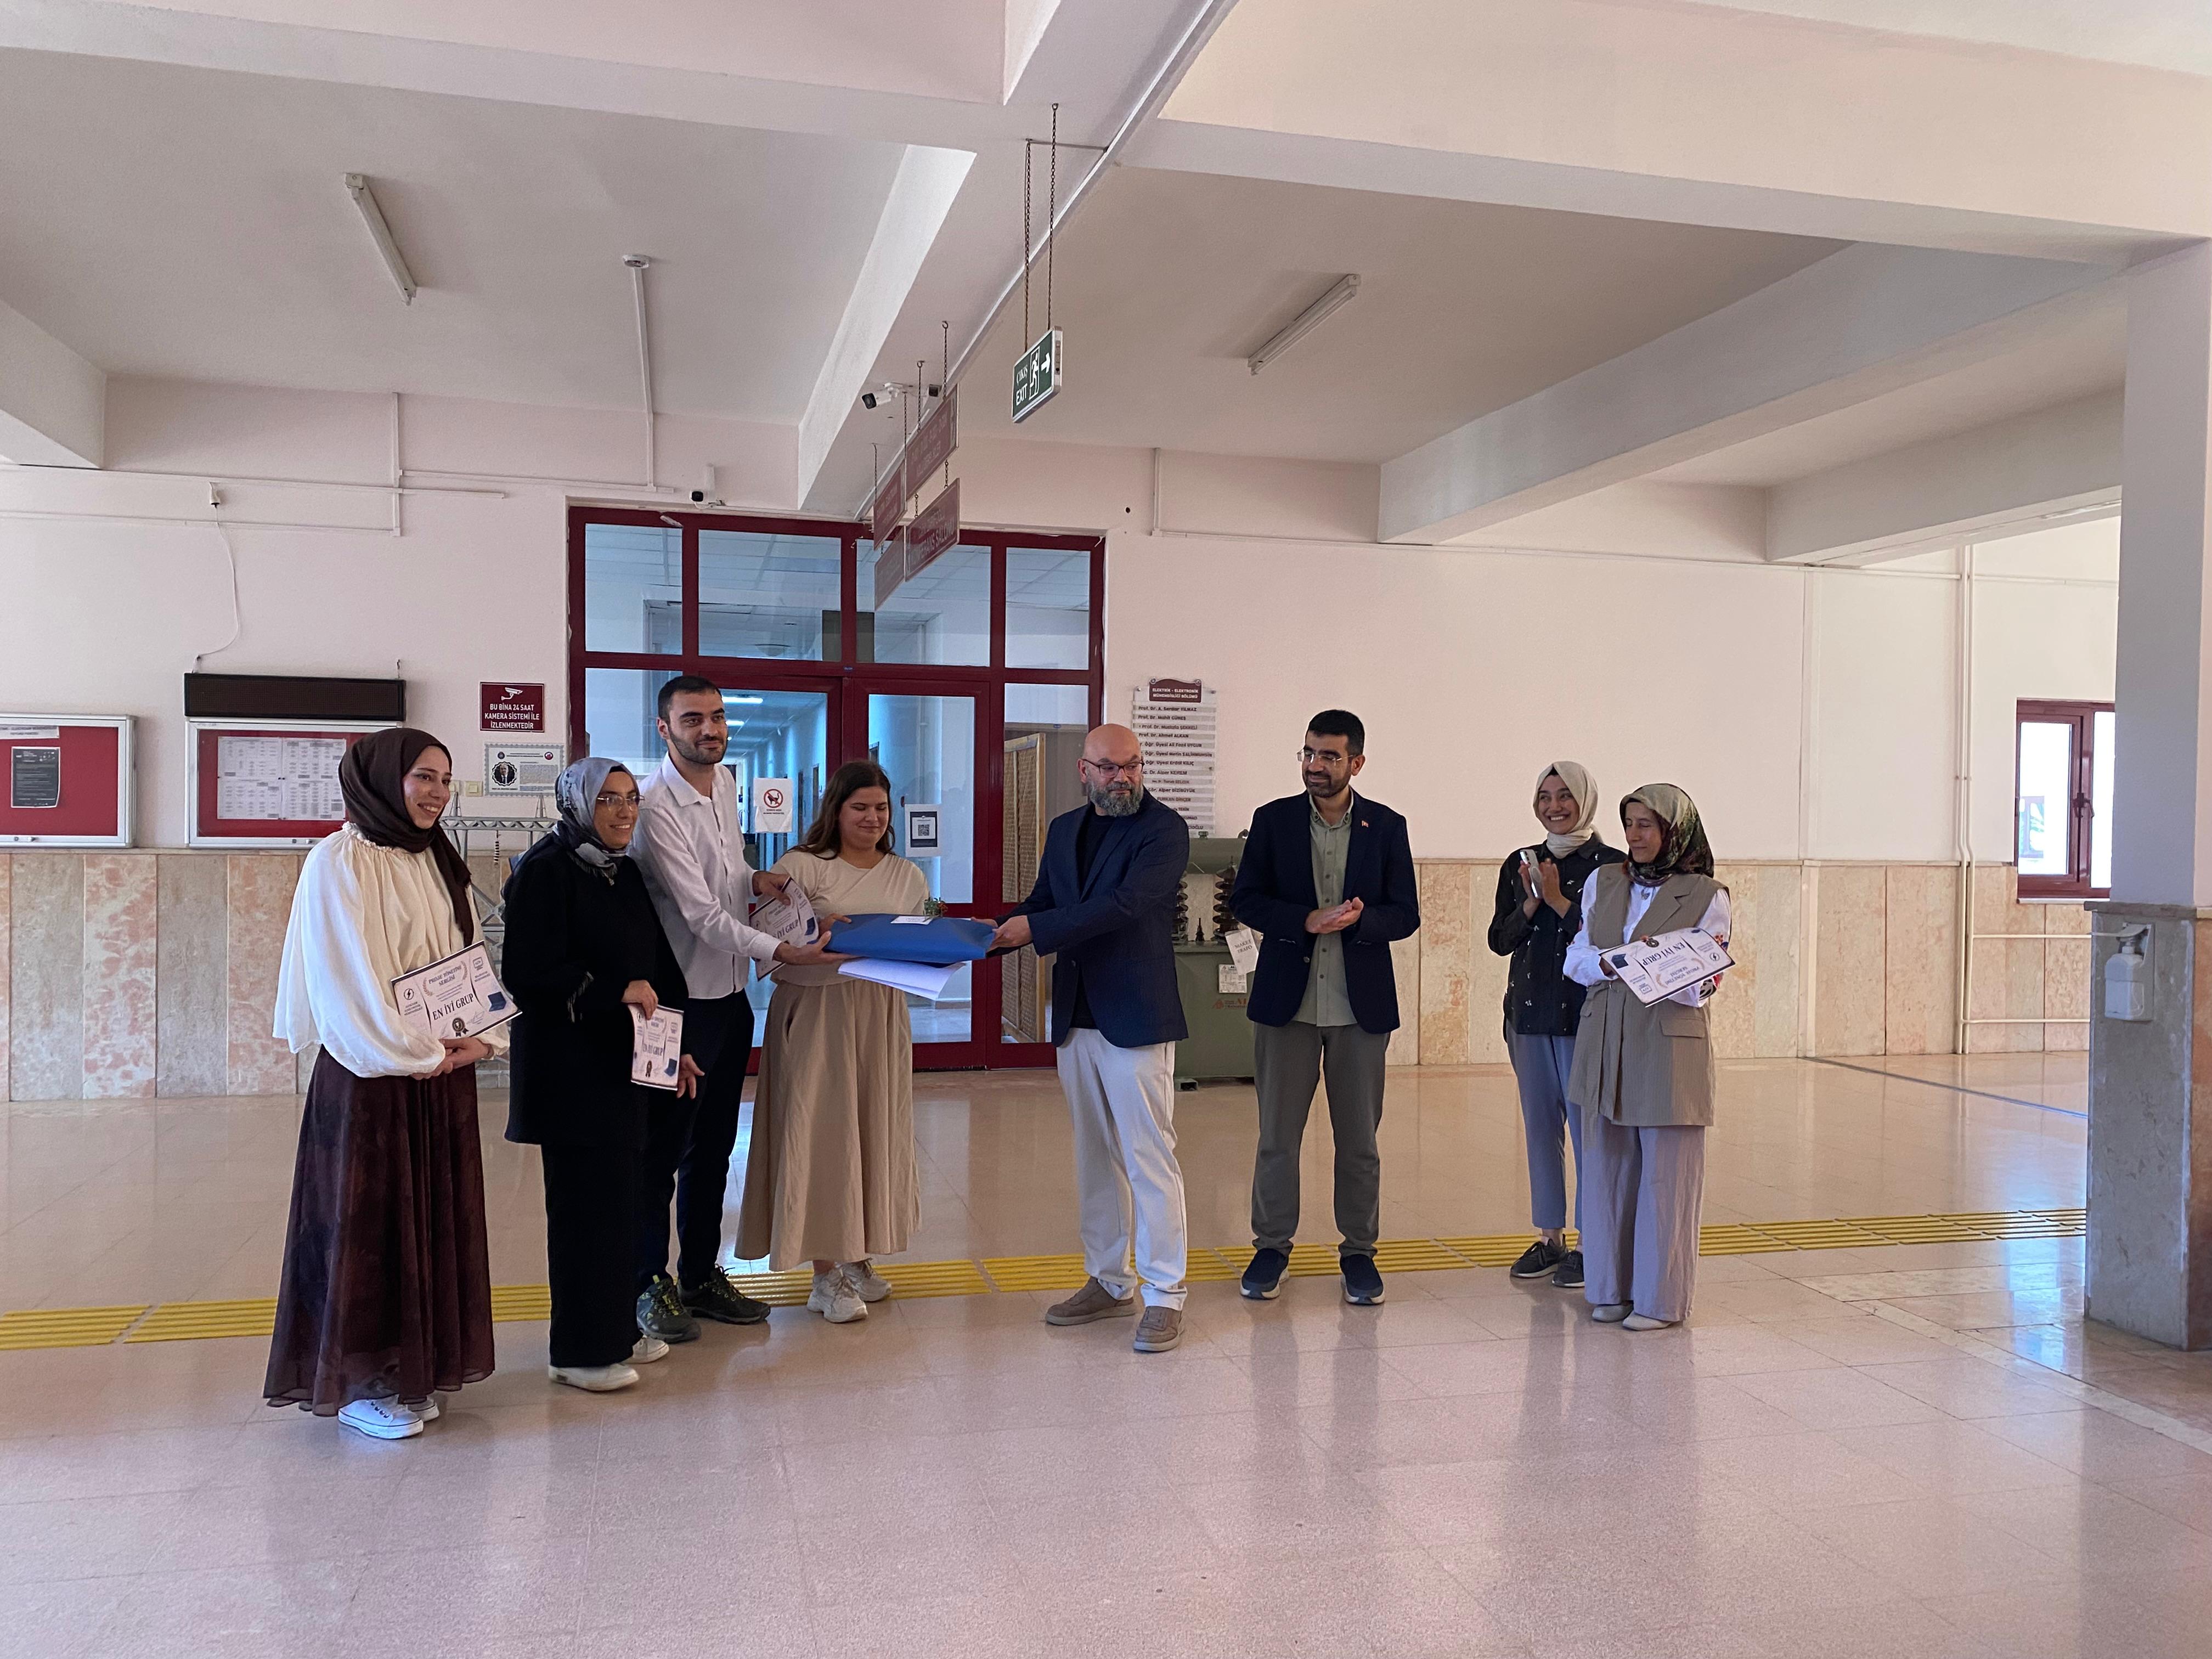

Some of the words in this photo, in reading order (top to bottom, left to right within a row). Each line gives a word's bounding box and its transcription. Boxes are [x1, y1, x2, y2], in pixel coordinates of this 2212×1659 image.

[1017, 364, 1028, 386] ÇIKIŞ
[1016, 383, 1028, 405] EXIT
[508, 712, 530, 720] SİSTEMİ
[490, 720, 534, 729] İZLENMEKTEDİR
[785, 919, 799, 933] GRUP
[1234, 939, 1251, 948] MAKET
[1238, 945, 1252, 953] TRAFO
[1673, 942, 1685, 951] EN
[1643, 953, 1662, 966] GRUP
[432, 1008, 444, 1020] EN
[444, 1000, 455, 1014] İYİ
[456, 993, 473, 1008] GRUP
